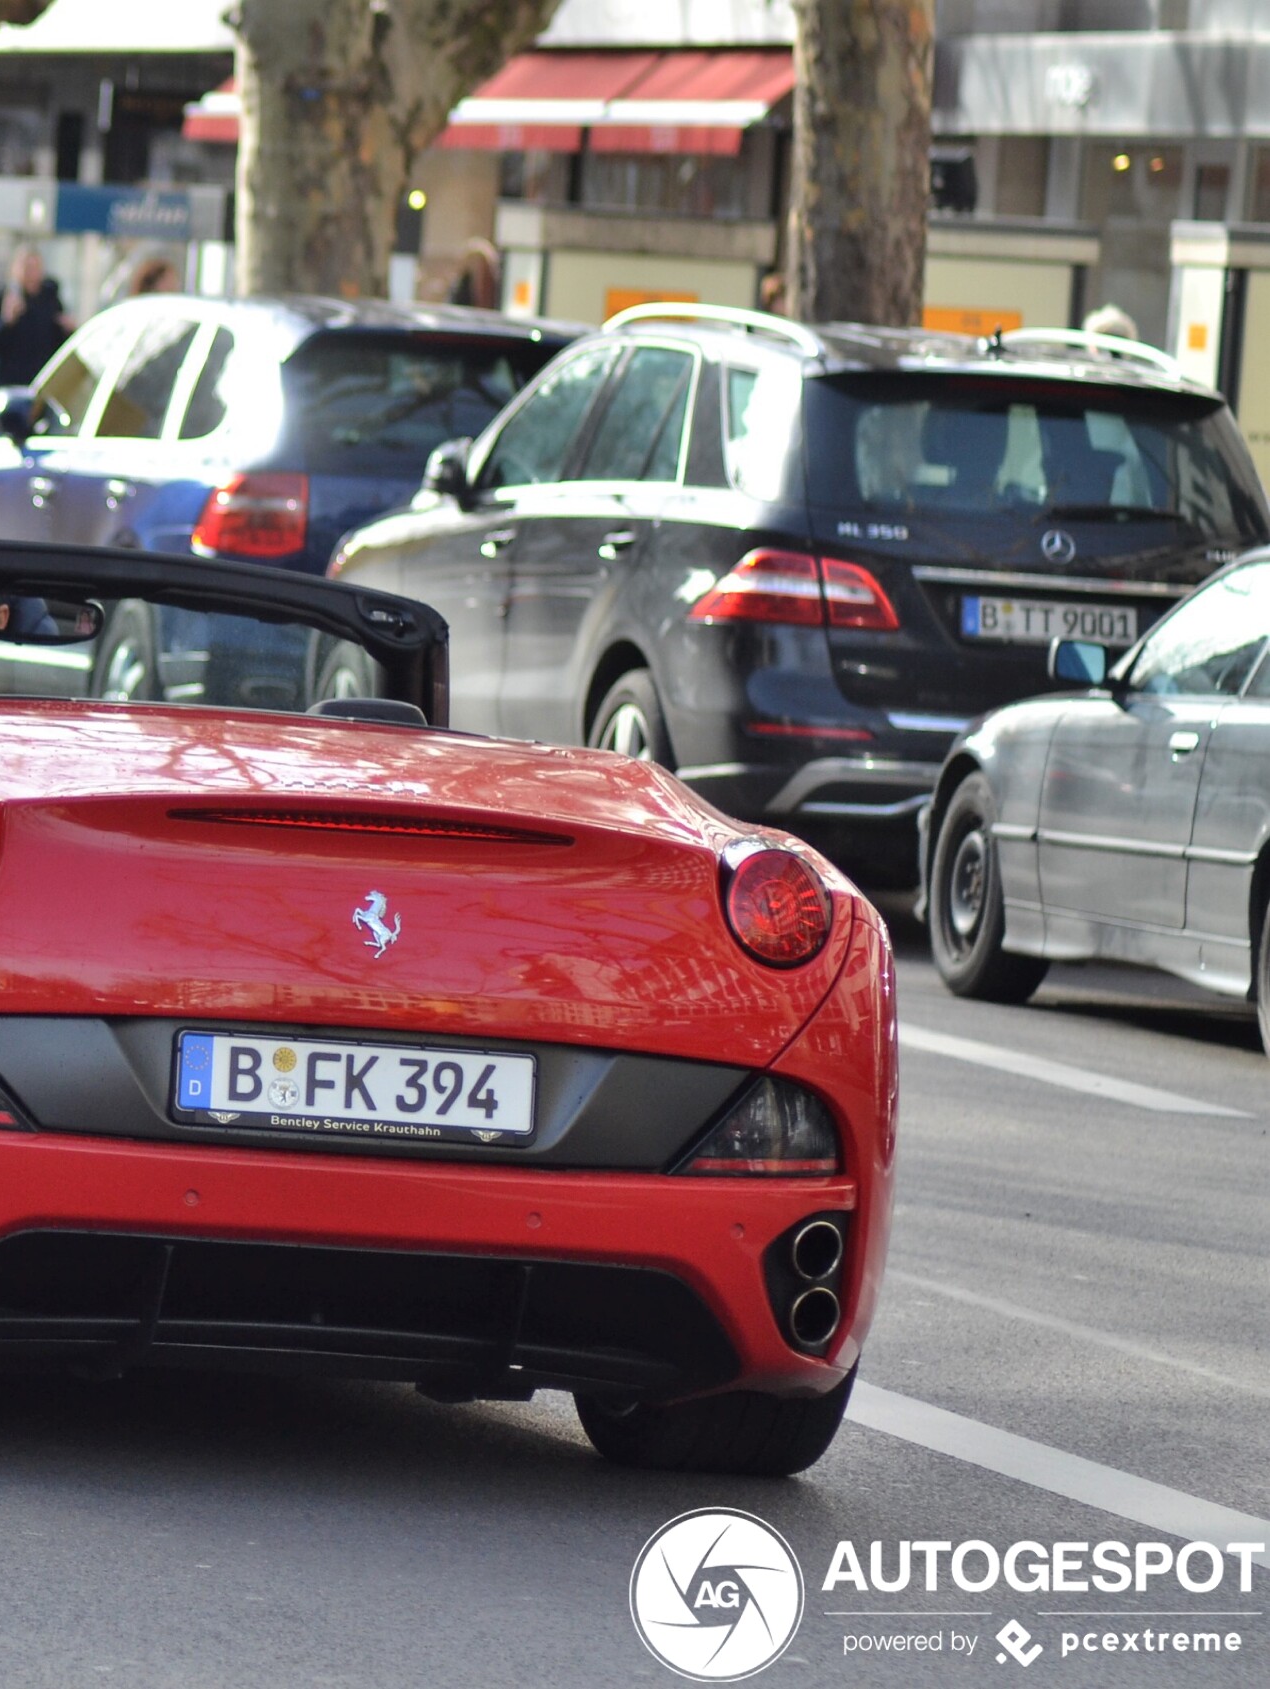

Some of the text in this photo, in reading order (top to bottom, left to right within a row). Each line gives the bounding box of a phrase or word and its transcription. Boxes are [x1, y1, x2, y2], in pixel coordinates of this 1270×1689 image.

[981, 603, 1129, 639] B TT 9001
[188, 1079, 202, 1096] D
[228, 1046, 499, 1120] B FK 394
[270, 1115, 441, 1137] Bentley Service Krauthahn
